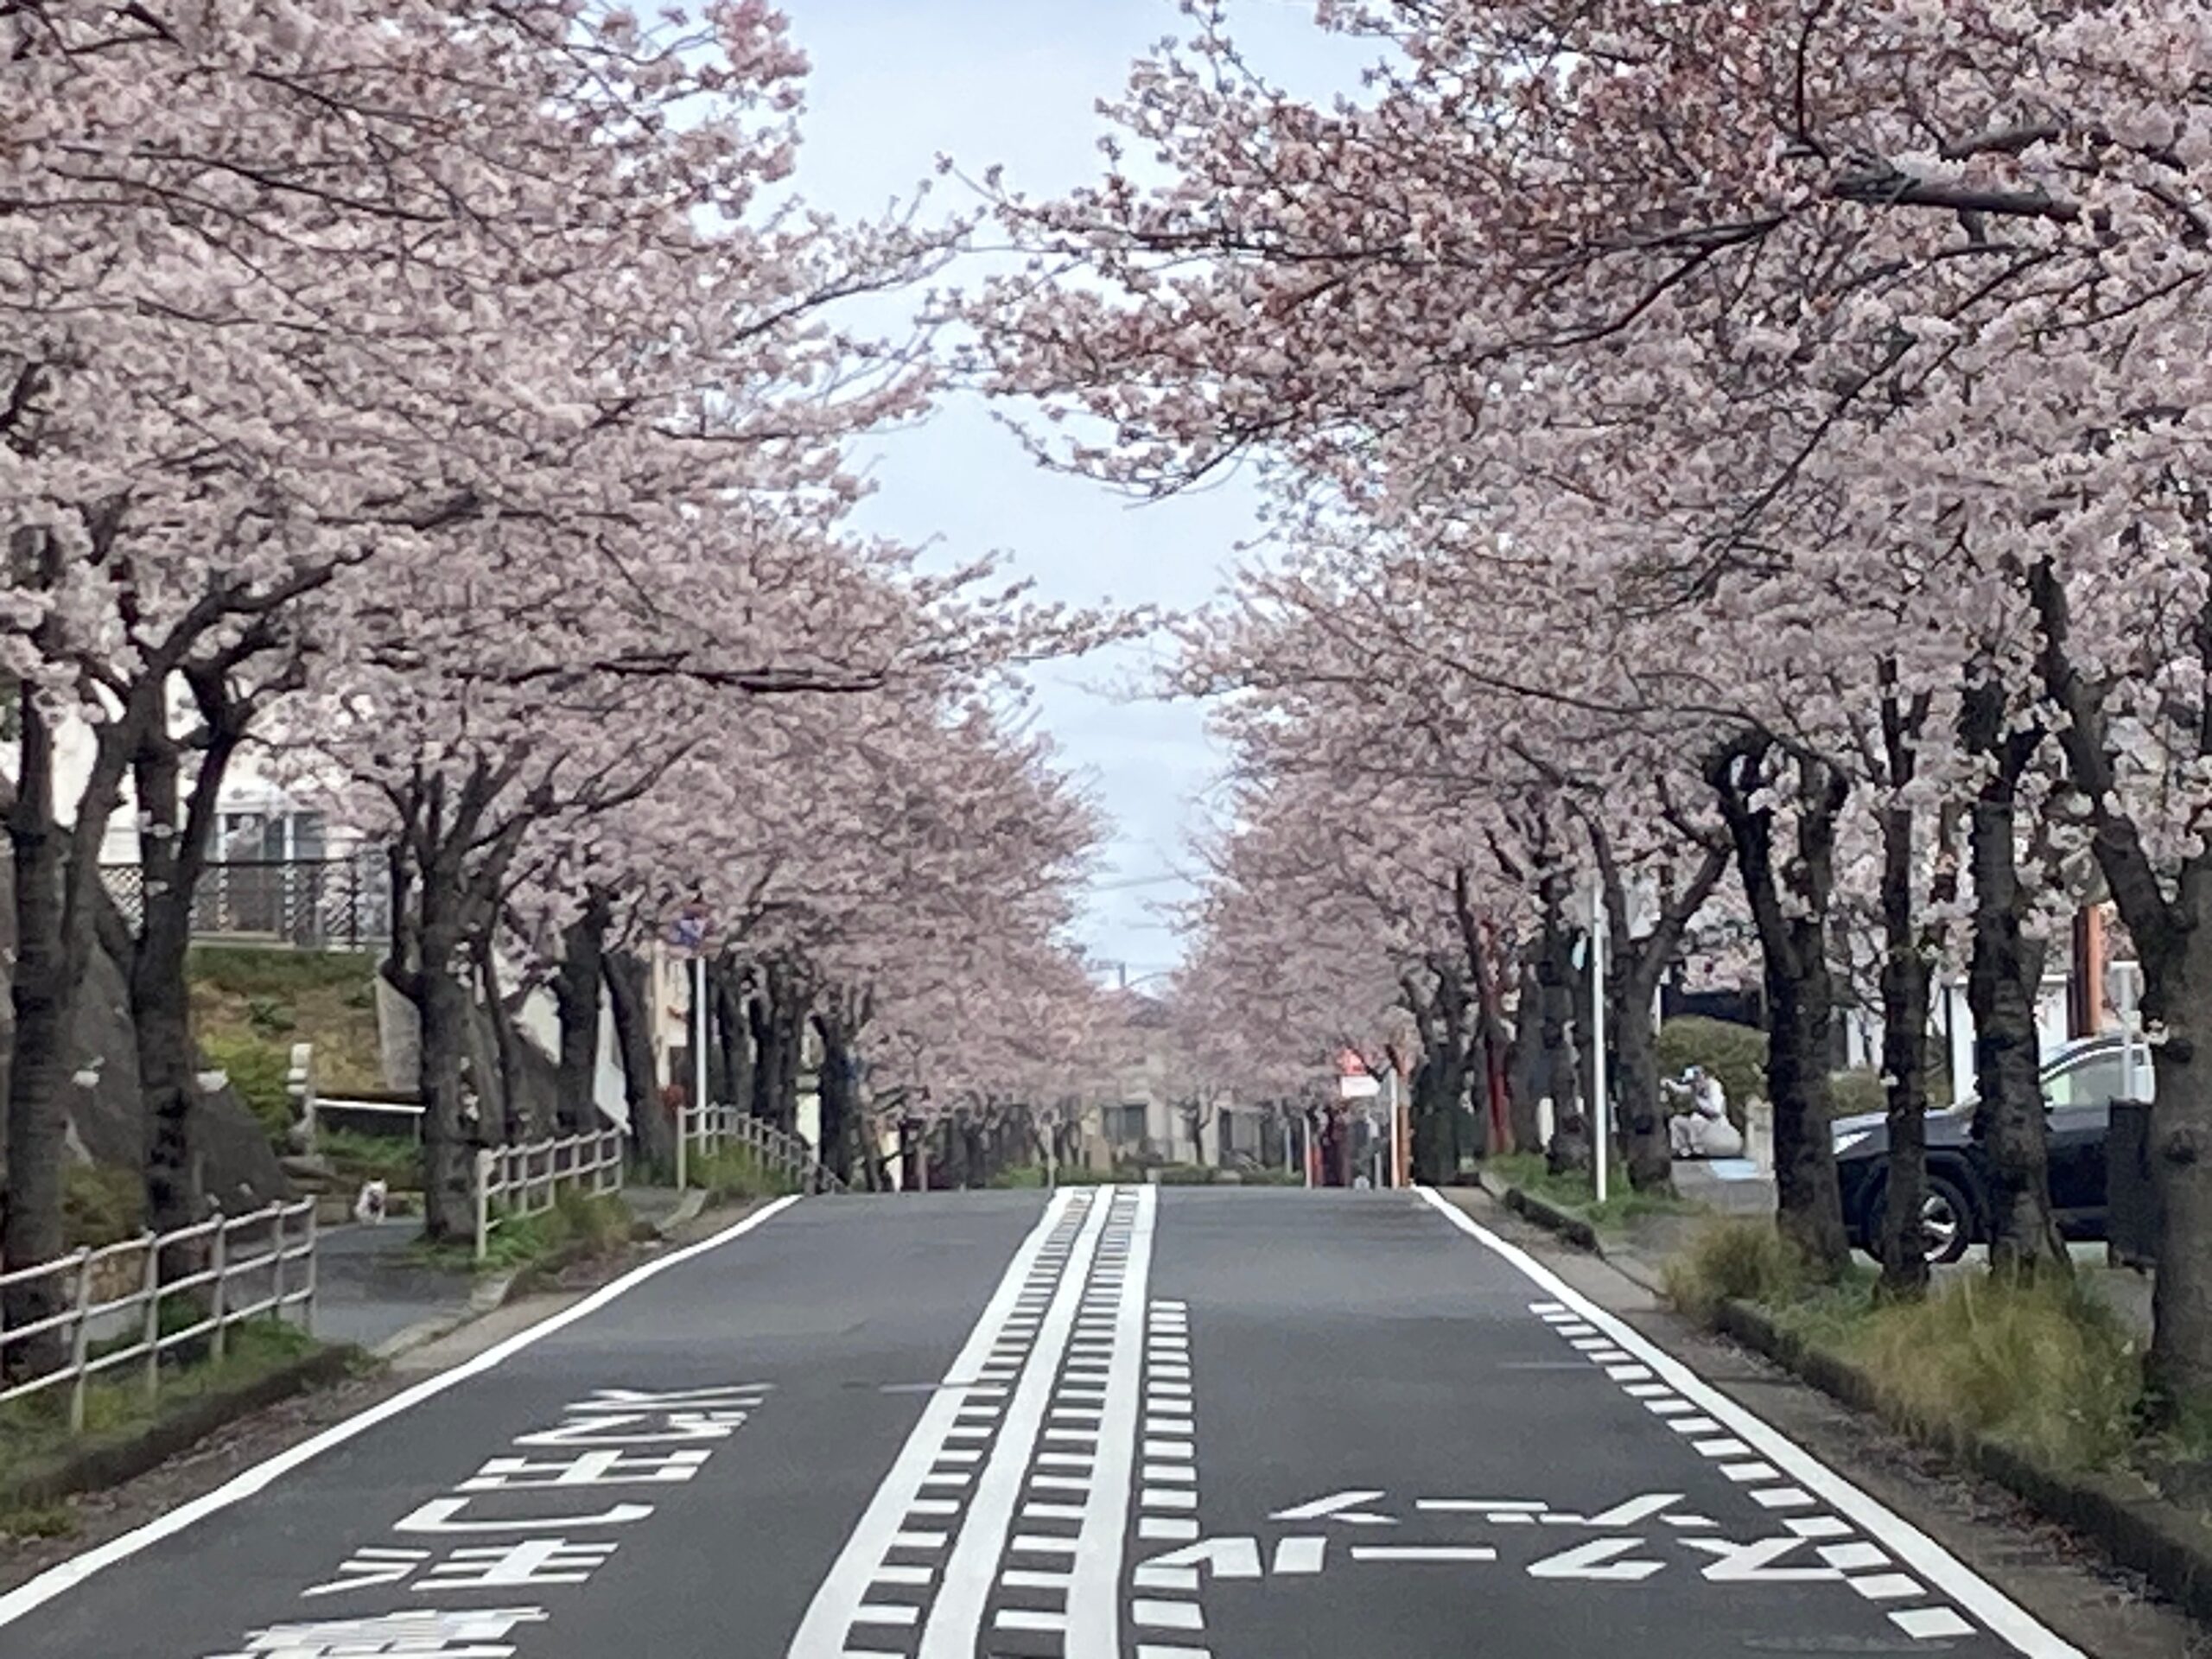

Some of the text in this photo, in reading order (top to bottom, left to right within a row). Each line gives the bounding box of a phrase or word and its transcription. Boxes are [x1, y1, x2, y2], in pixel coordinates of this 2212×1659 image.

[1267, 1489, 1719, 1527] ゾーン
[1143, 1535, 1846, 1580] スクール
